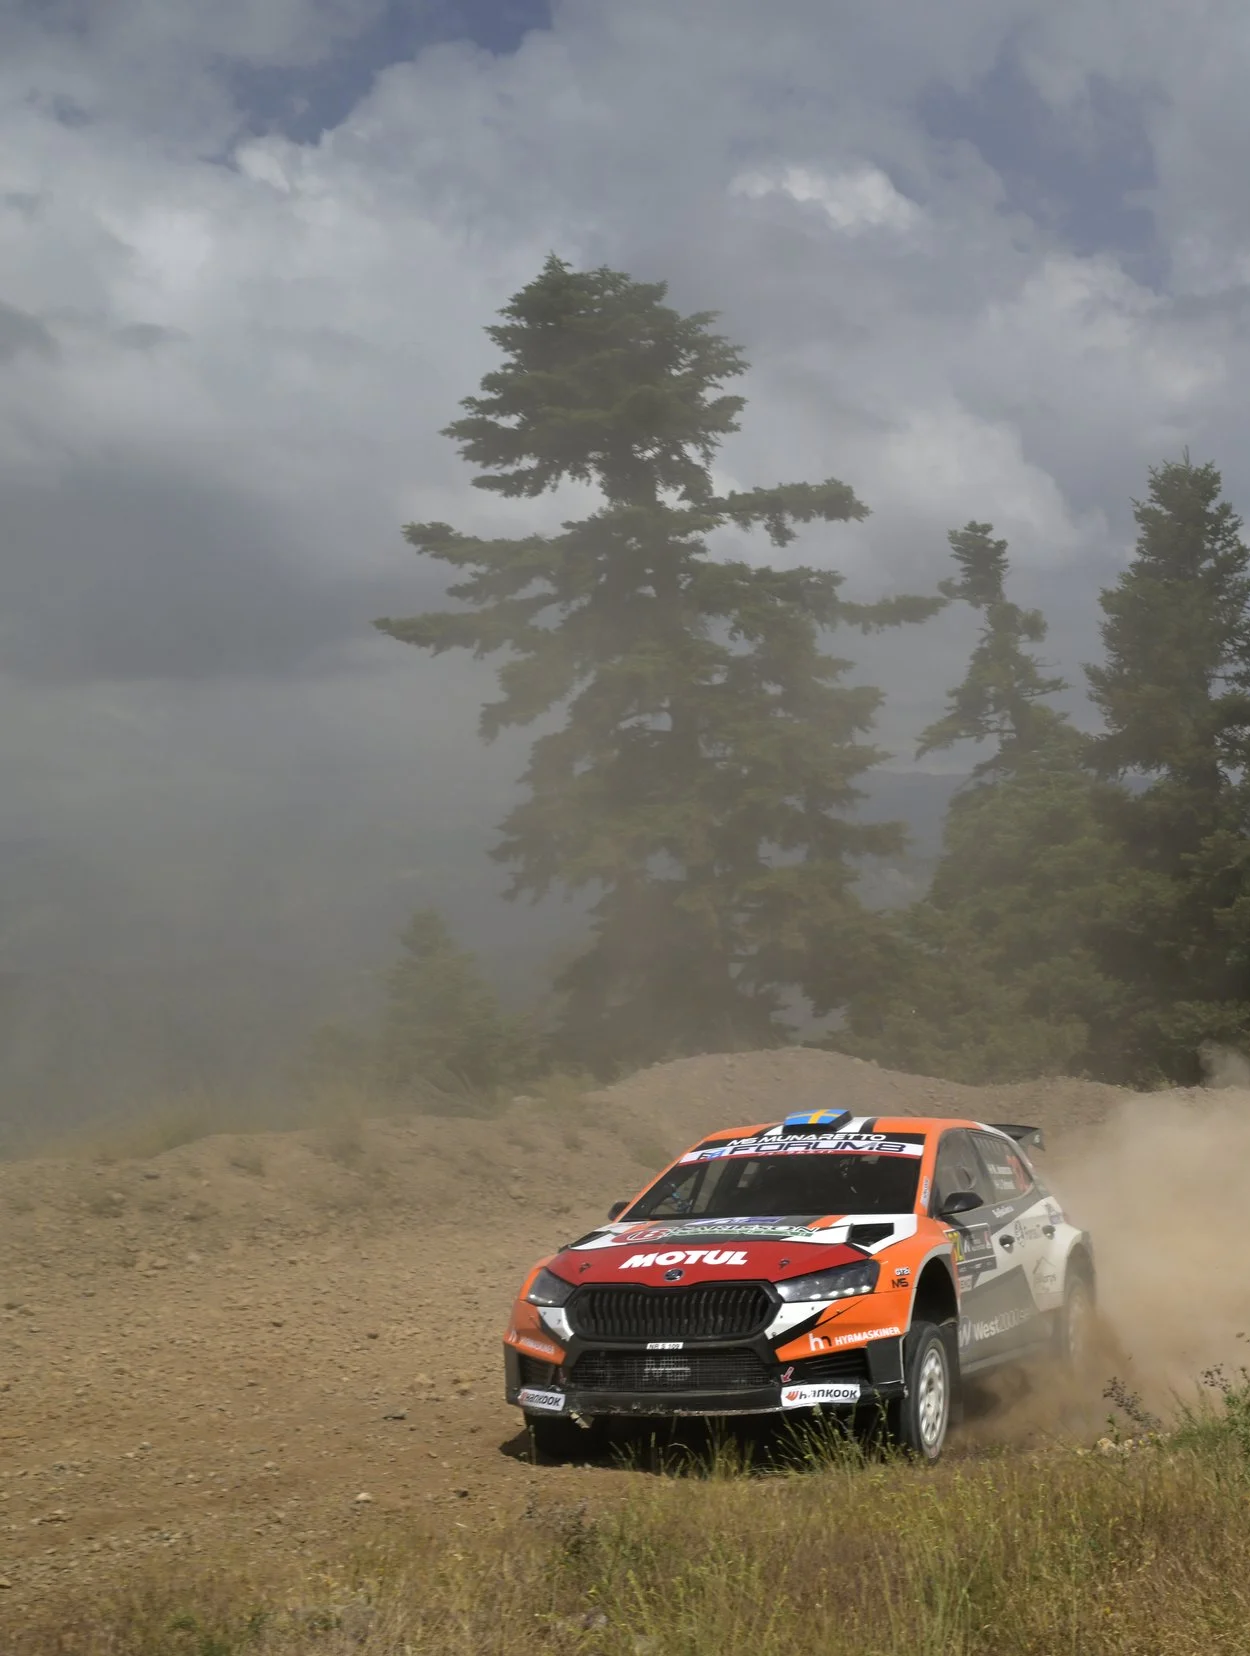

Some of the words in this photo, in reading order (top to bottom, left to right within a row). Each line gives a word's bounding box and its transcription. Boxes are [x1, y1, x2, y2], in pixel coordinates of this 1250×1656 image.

[759, 1133, 887, 1144] MUNARETTO
[729, 1141, 906, 1155] FORUM8
[618, 1250, 748, 1269] MOTUL
[834, 1327, 902, 1346] HYRMASKINER
